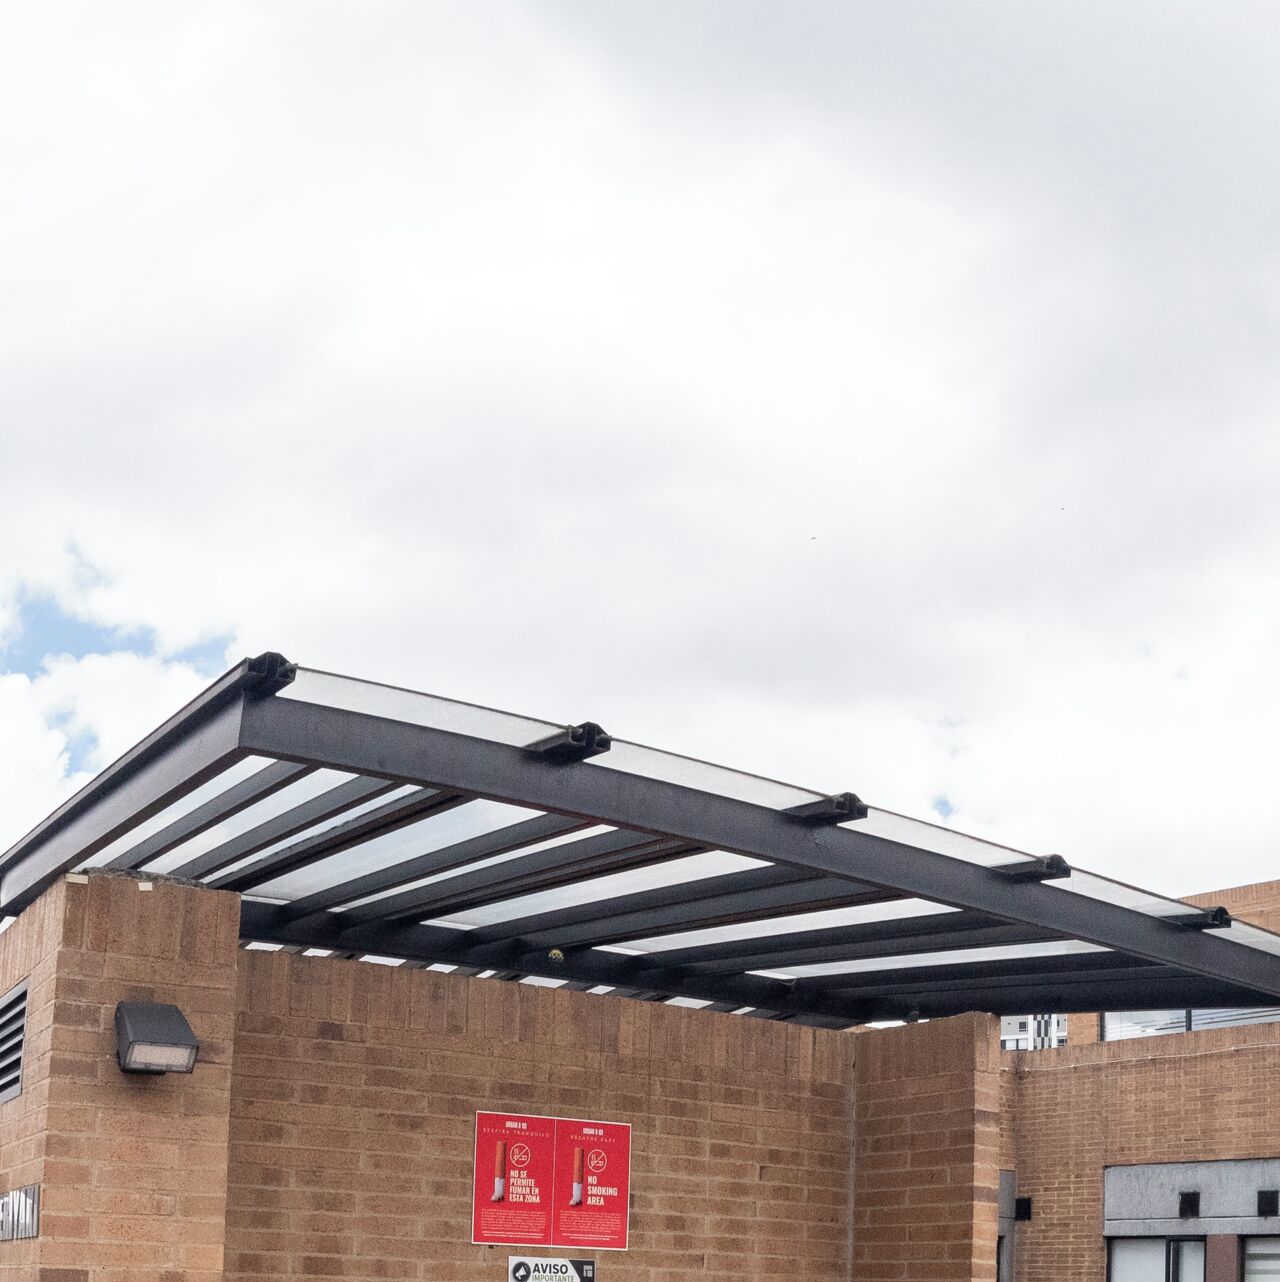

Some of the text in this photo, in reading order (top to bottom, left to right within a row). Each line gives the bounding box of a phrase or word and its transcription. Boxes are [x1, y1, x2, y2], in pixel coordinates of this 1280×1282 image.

[510, 1170, 519, 1178] NO
[510, 1178, 535, 1186] PERMITE
[588, 1176, 597, 1184] NO
[510, 1186, 539, 1195] FUMAR EN
[588, 1186, 618, 1196] SMOKING
[510, 1194, 540, 1203] ESTA ZONA
[587, 1196, 604, 1205] AREA
[532, 1263, 569, 1274] AVISO
[532, 1275, 575, 1282] IMPORTANTE
